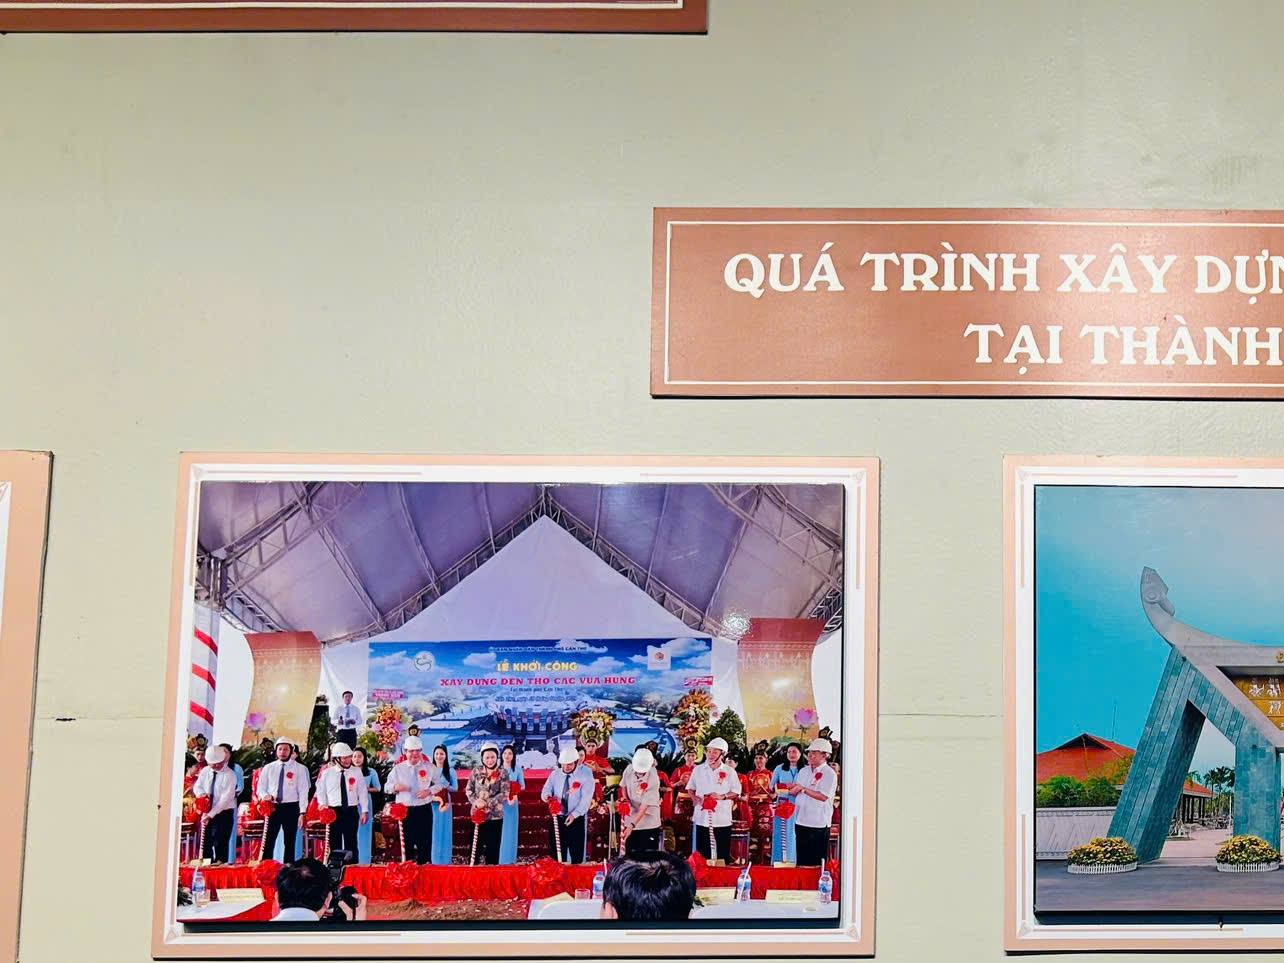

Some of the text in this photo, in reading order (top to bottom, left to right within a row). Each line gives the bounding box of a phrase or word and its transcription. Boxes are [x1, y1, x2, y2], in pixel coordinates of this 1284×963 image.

[725, 243, 844, 298] QUÁ
[861, 243, 1040, 291] TRÌNH
[1056, 243, 1178, 293] XÂY
[964, 324, 1063, 374] TẠI
[1079, 314, 1283, 366] THÀNH
